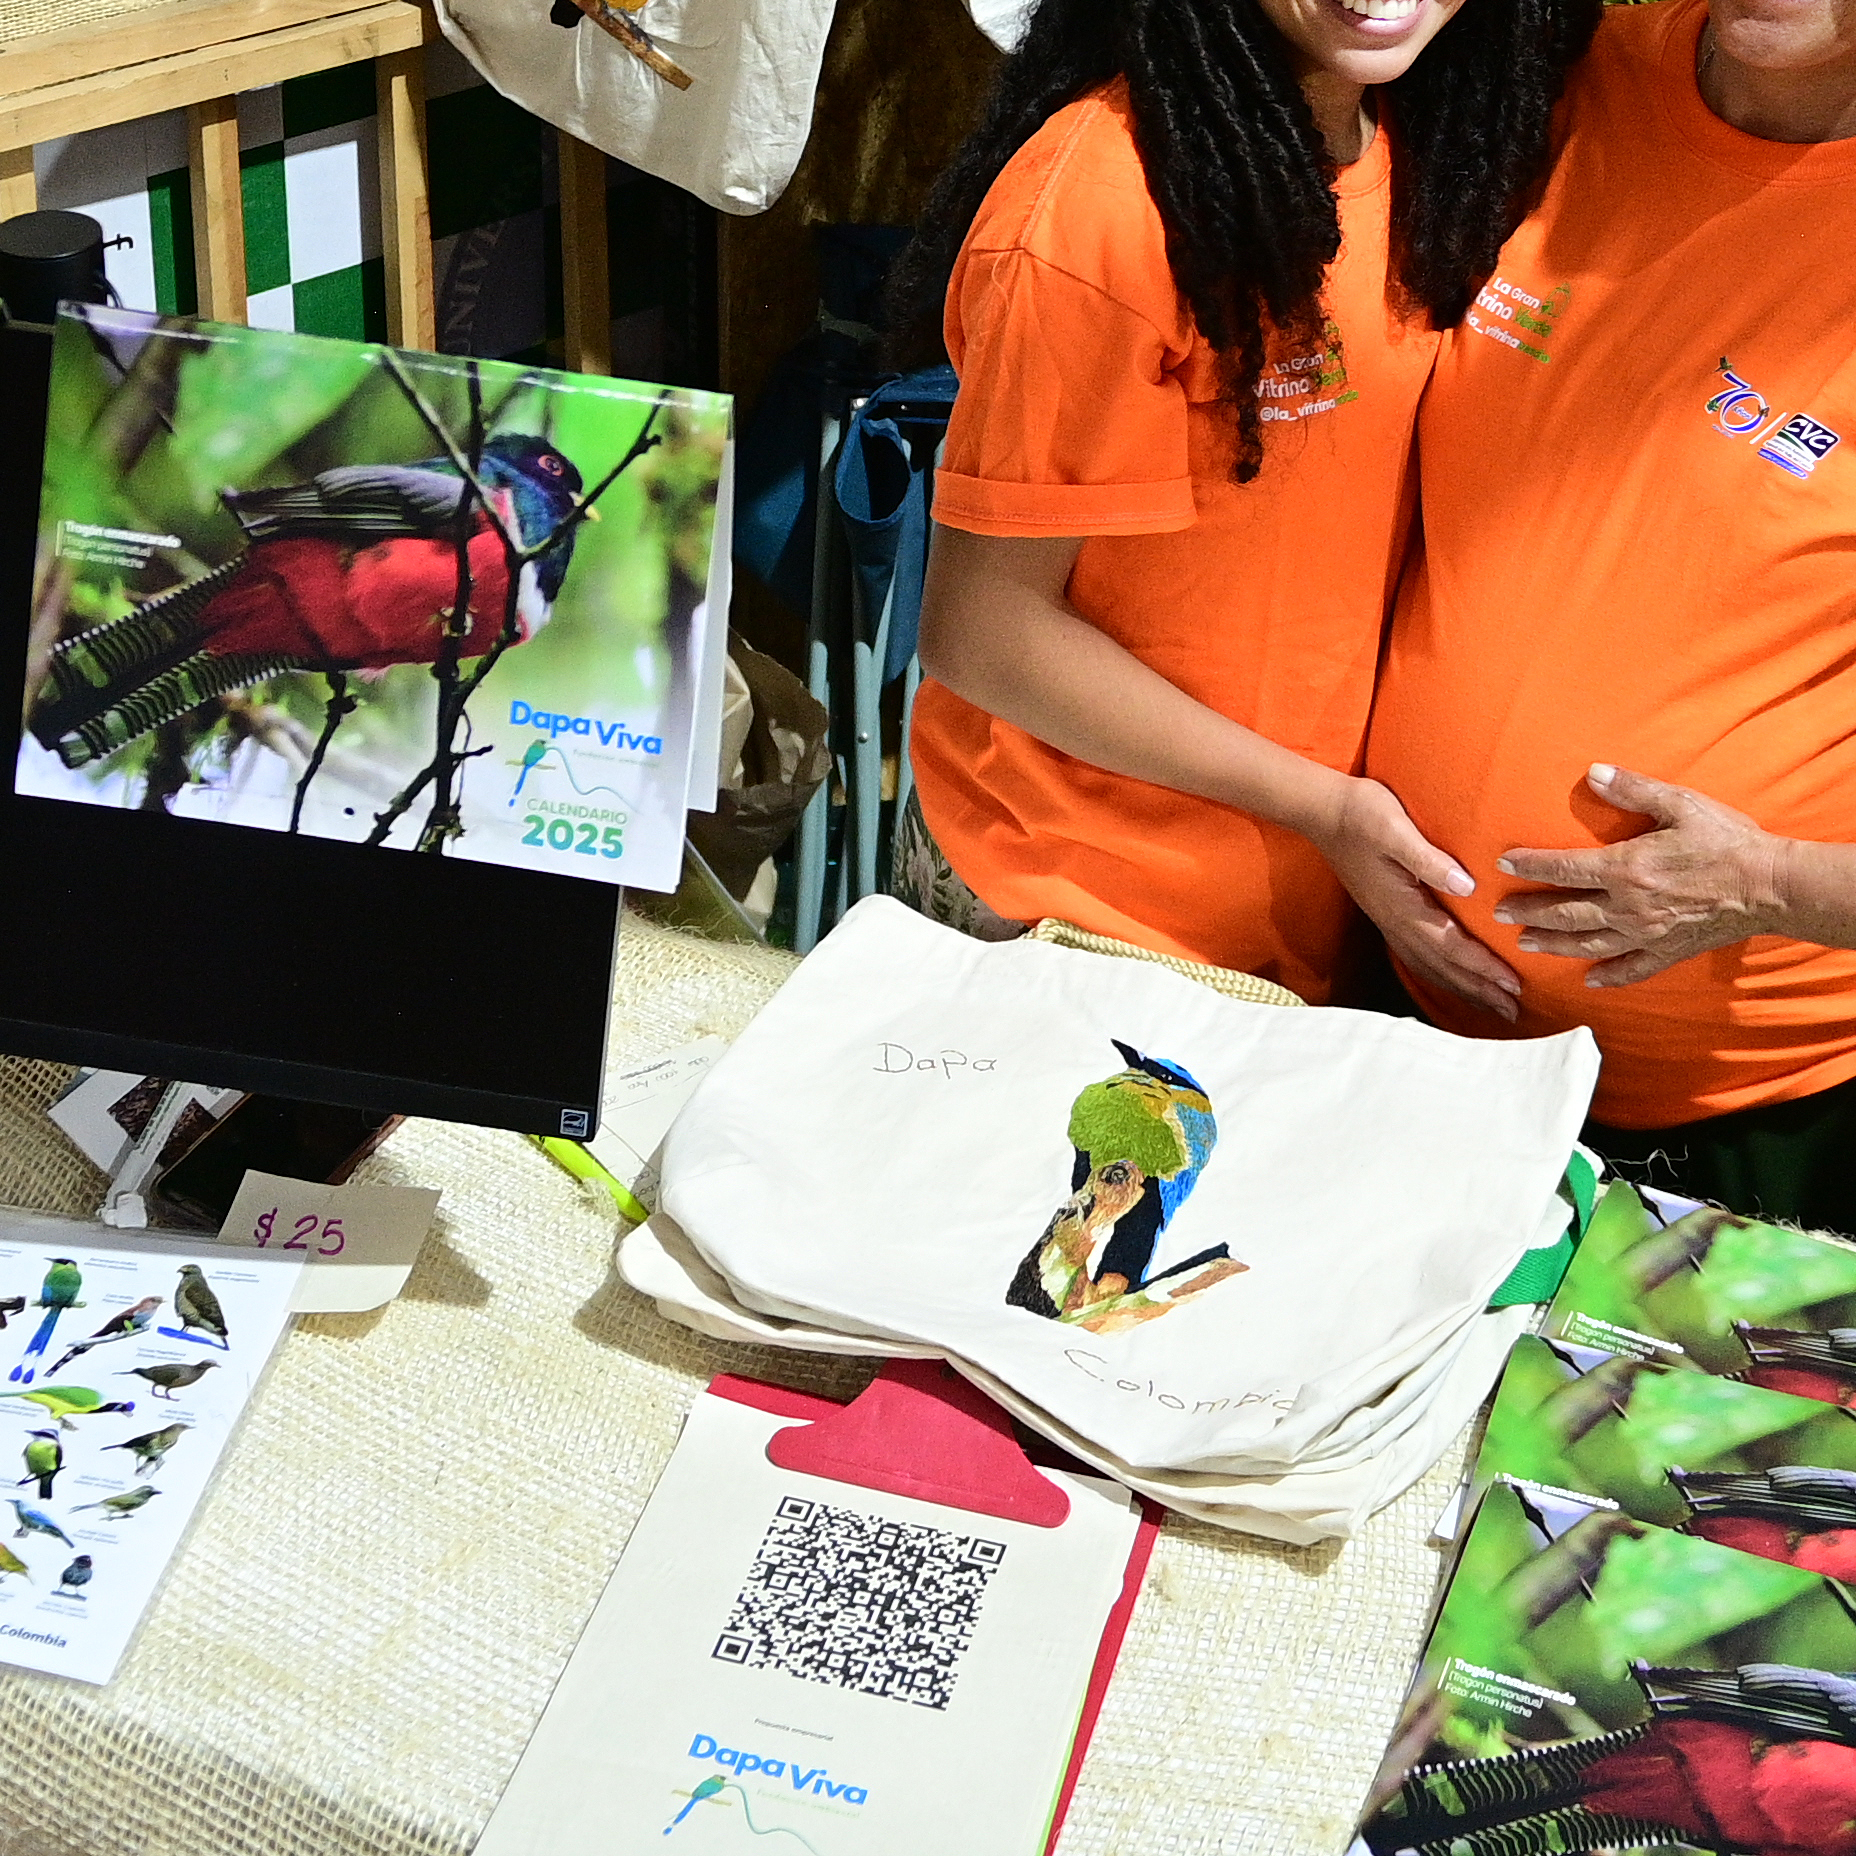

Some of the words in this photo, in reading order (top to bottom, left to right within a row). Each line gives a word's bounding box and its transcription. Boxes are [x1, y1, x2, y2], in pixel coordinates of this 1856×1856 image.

[1493, 277, 1511, 295] La
[1511, 287, 1541, 309] Gran
[1784, 418, 1836, 450] CVC
[509, 699, 591, 739] Dapa
[594, 719, 664, 756] Viva
[526, 797, 628, 825] CALENDARIO
[520, 814, 624, 860] 2025
[0, 1623, 67, 1649] Colombia
[1454, 1657, 1495, 1681] Trogón
[1495, 1673, 1577, 1706] enmascarado
[688, 1733, 786, 1778] Dapa
[790, 1763, 869, 1806] Viva
